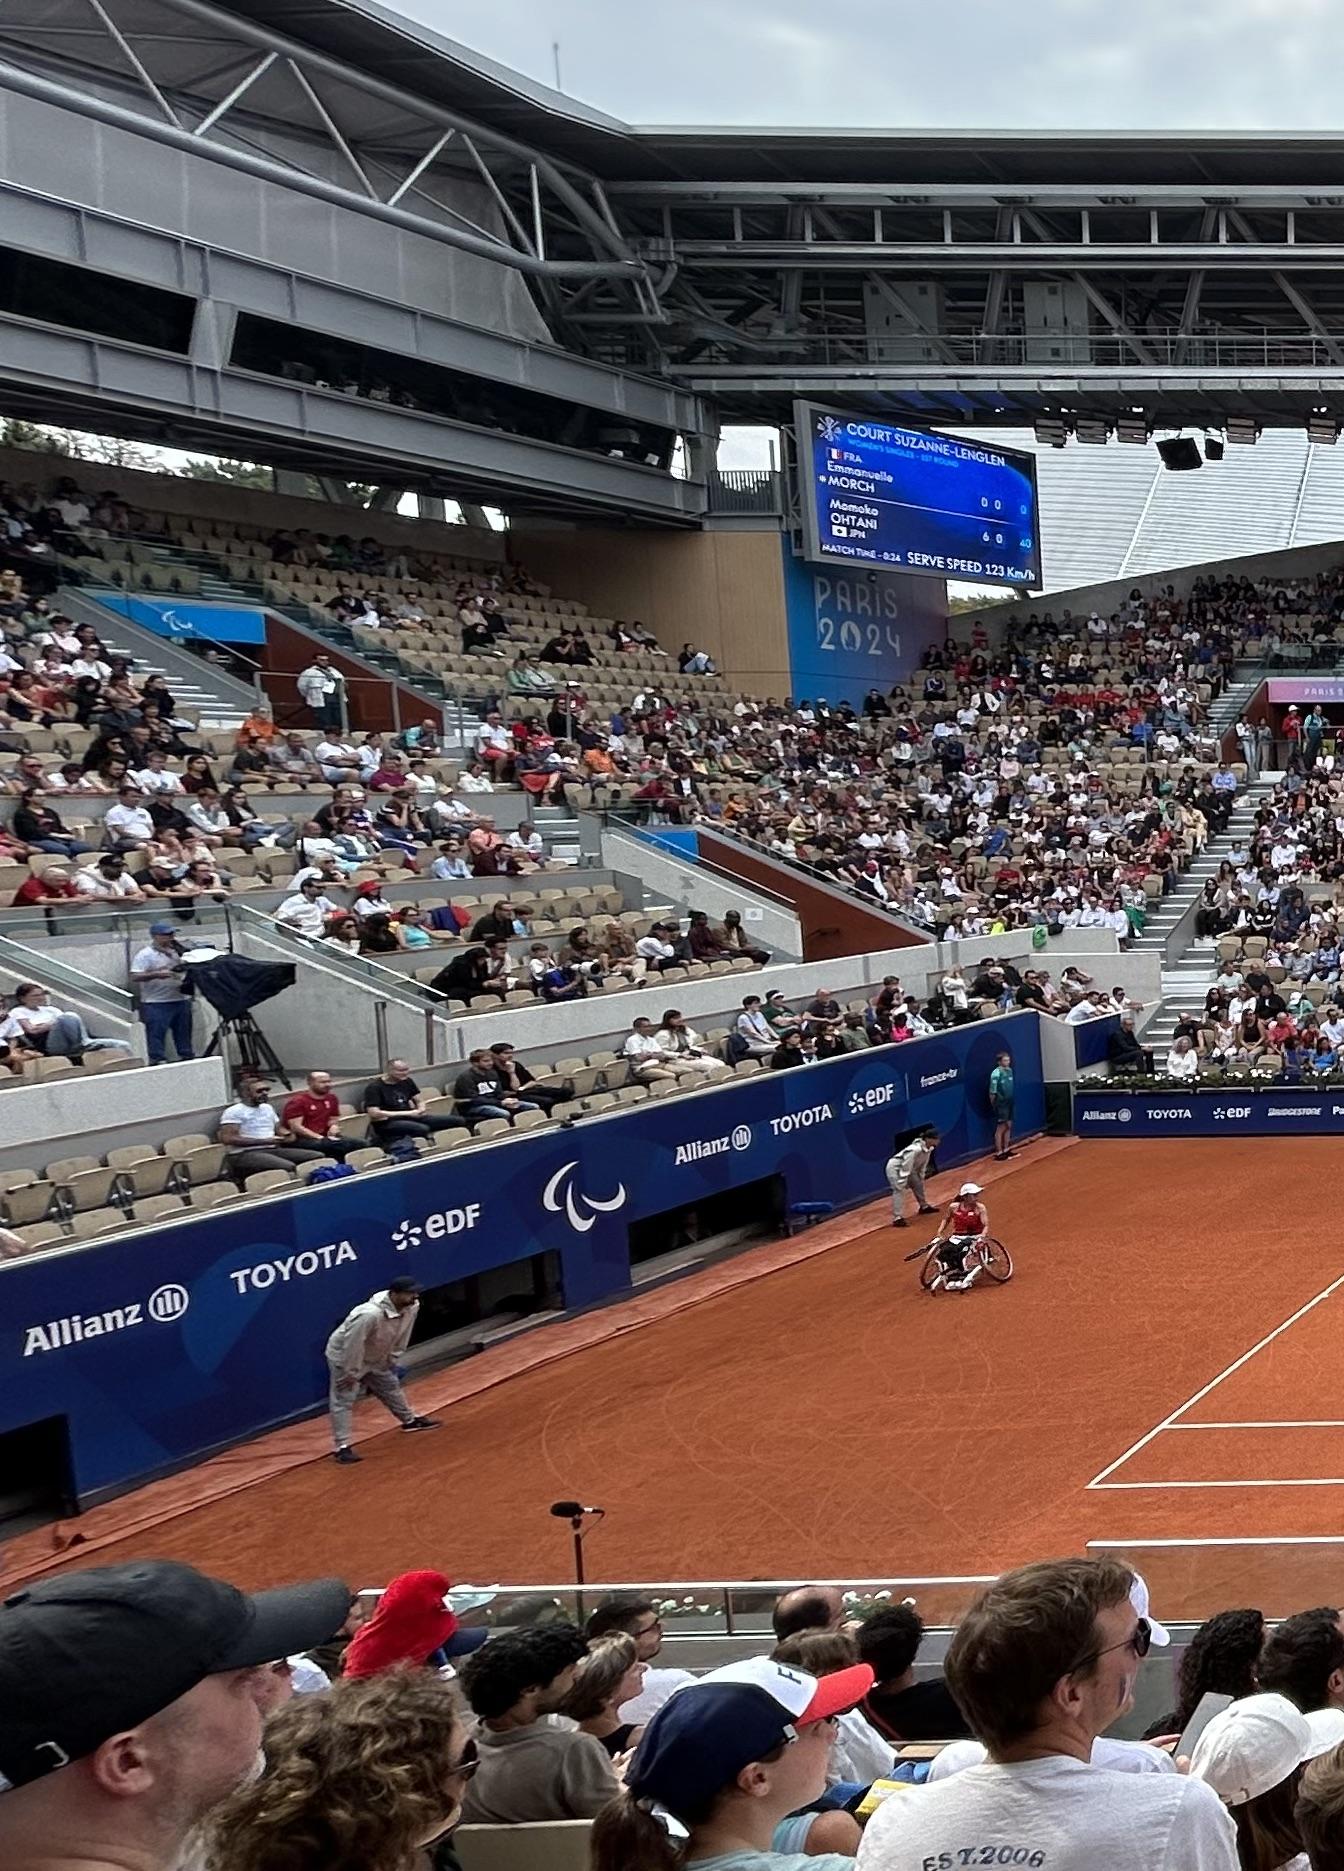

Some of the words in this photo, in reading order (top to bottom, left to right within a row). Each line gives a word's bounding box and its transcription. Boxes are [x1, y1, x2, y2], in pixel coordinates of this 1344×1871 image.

[846, 422, 893, 443] COURT
[894, 433, 1006, 468] SUZANNE-LENGLEN
[844, 451, 863, 464] FRA
[827, 459, 894, 484] Emmanuelle
[827, 475, 876, 493] MORCH
[830, 512, 878, 530] OHTANI
[848, 528, 866, 540] JPN
[982, 531, 991, 543] 6
[995, 533, 1004, 545] 0
[821, 543, 855, 556] MATCH
[907, 551, 945, 569] SERVE
[946, 557, 983, 574] SPEED
[984, 563, 1005, 577] 123
[1006, 566, 1036, 581] Km/h
[819, 616, 901, 657] 2024
[770, 1104, 833, 1136] TOYOTA
[1082, 1110, 1118, 1122] Allianz
[1146, 1107, 1193, 1121] TOYOTA
[674, 1136, 731, 1166] Allianz
[229, 1240, 358, 1295] TOYOTA
[22, 1303, 143, 1357] Allianz
